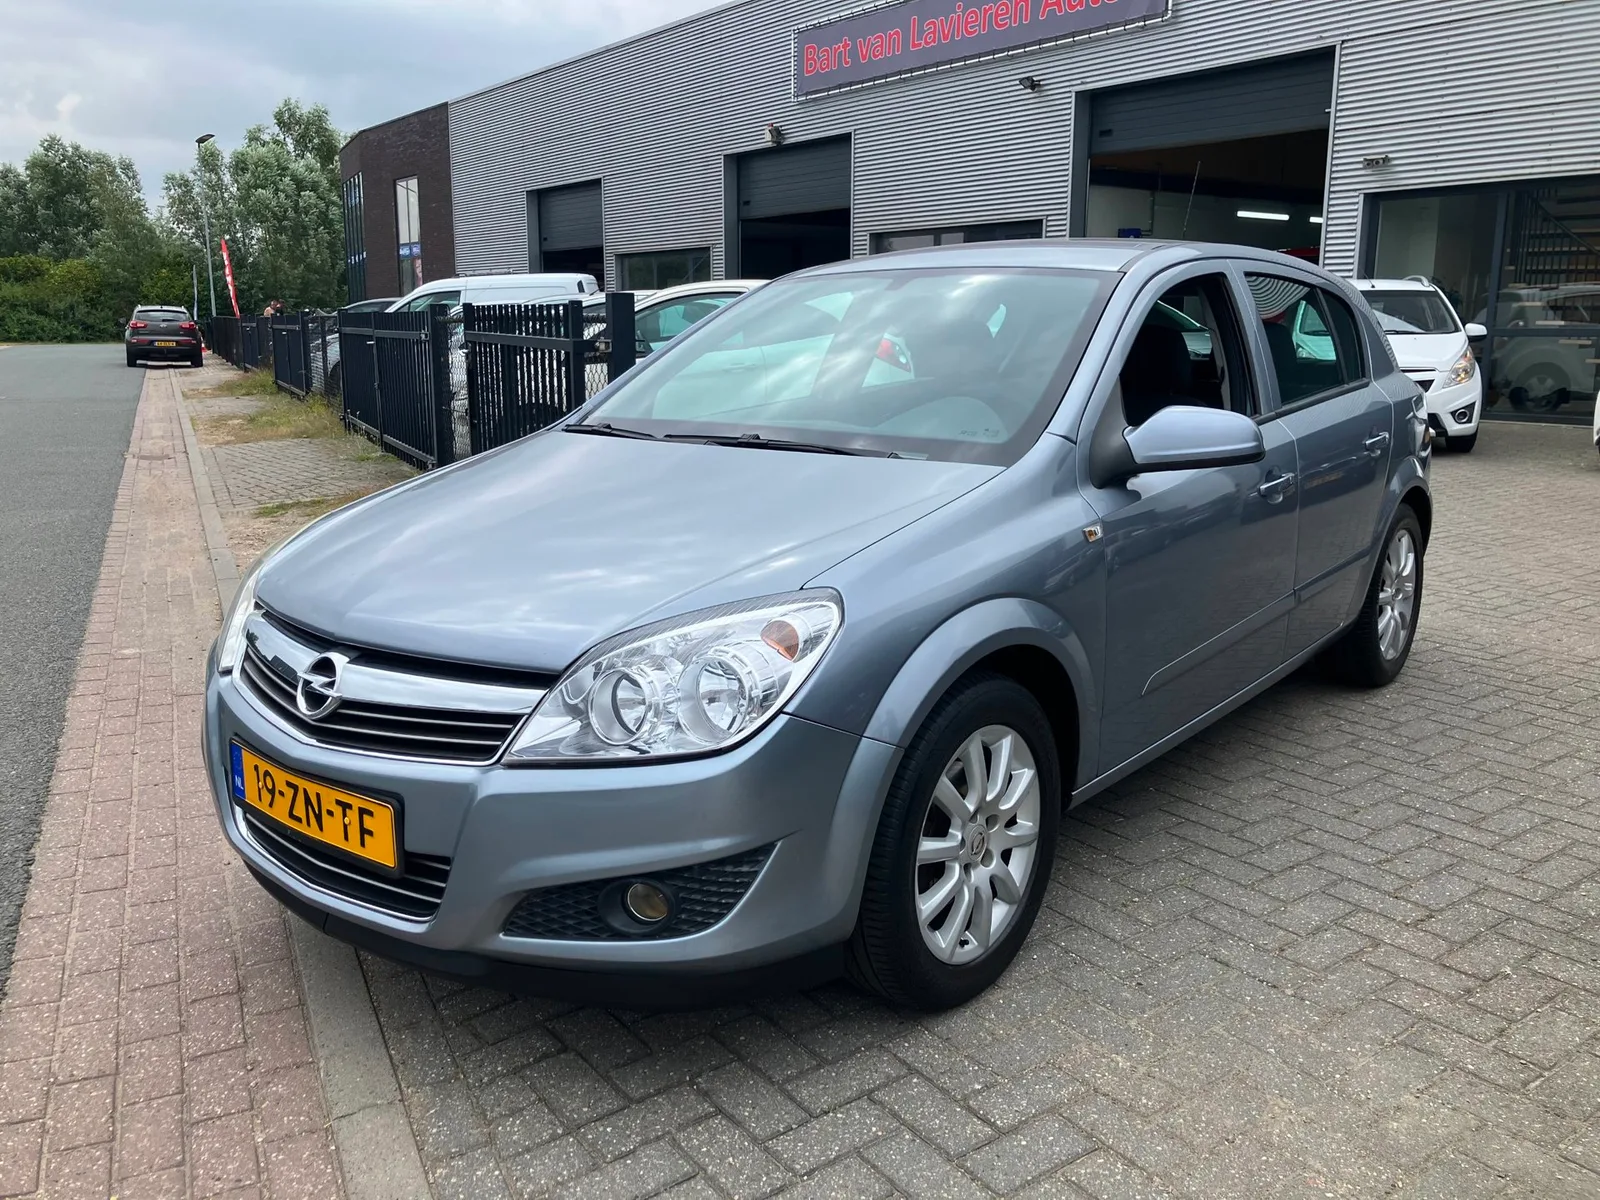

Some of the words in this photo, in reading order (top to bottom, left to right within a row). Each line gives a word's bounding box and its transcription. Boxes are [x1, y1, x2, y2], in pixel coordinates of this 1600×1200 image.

[804, 37, 851, 76] Bart
[857, 28, 901, 63] van
[909, 0, 1031, 50] Lavieren
[234, 775, 244, 790] NL
[253, 763, 374, 849] 19-ZN-TF
